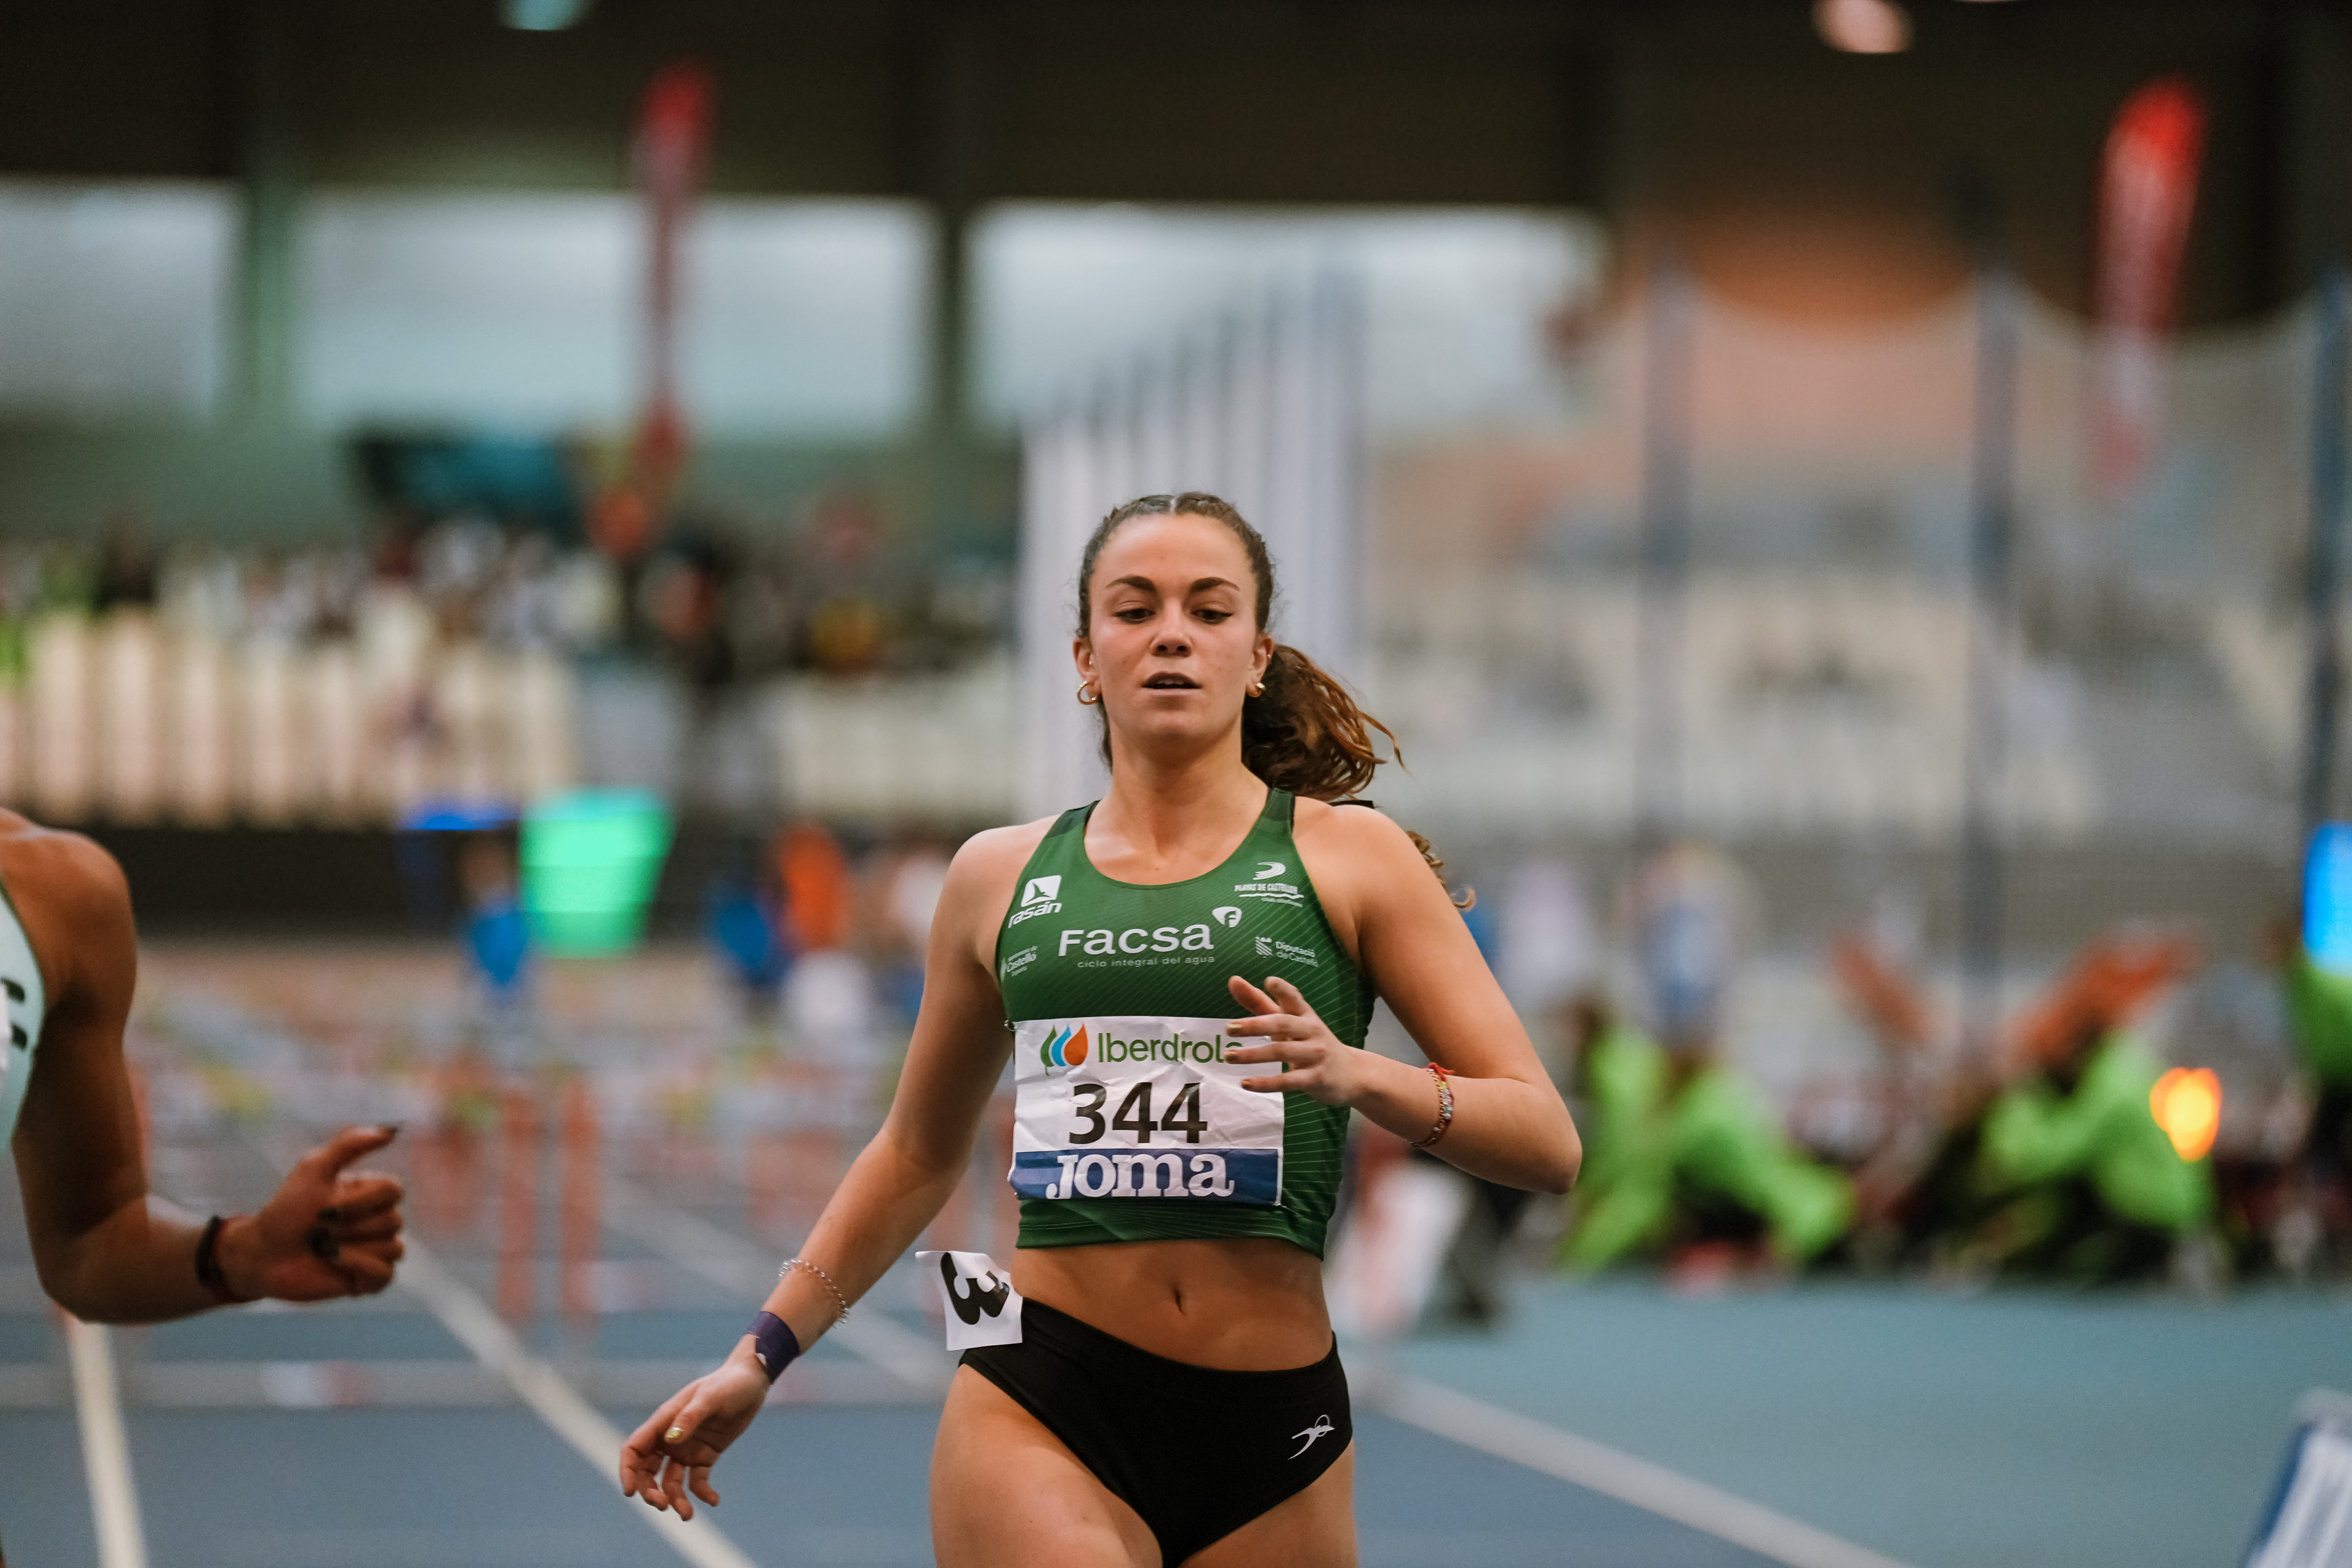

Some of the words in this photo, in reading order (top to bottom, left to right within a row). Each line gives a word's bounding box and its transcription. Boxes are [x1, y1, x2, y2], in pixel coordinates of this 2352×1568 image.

[1058, 924, 1214, 957] Facsa
[1077, 959, 1107, 968] ciclo
[1111, 957, 1158, 967] integral
[1162, 955, 1180, 964] del
[1185, 955, 1215, 965] agua
[1069, 1082, 1208, 1144] 344
[940, 1252, 1010, 1325] 3
